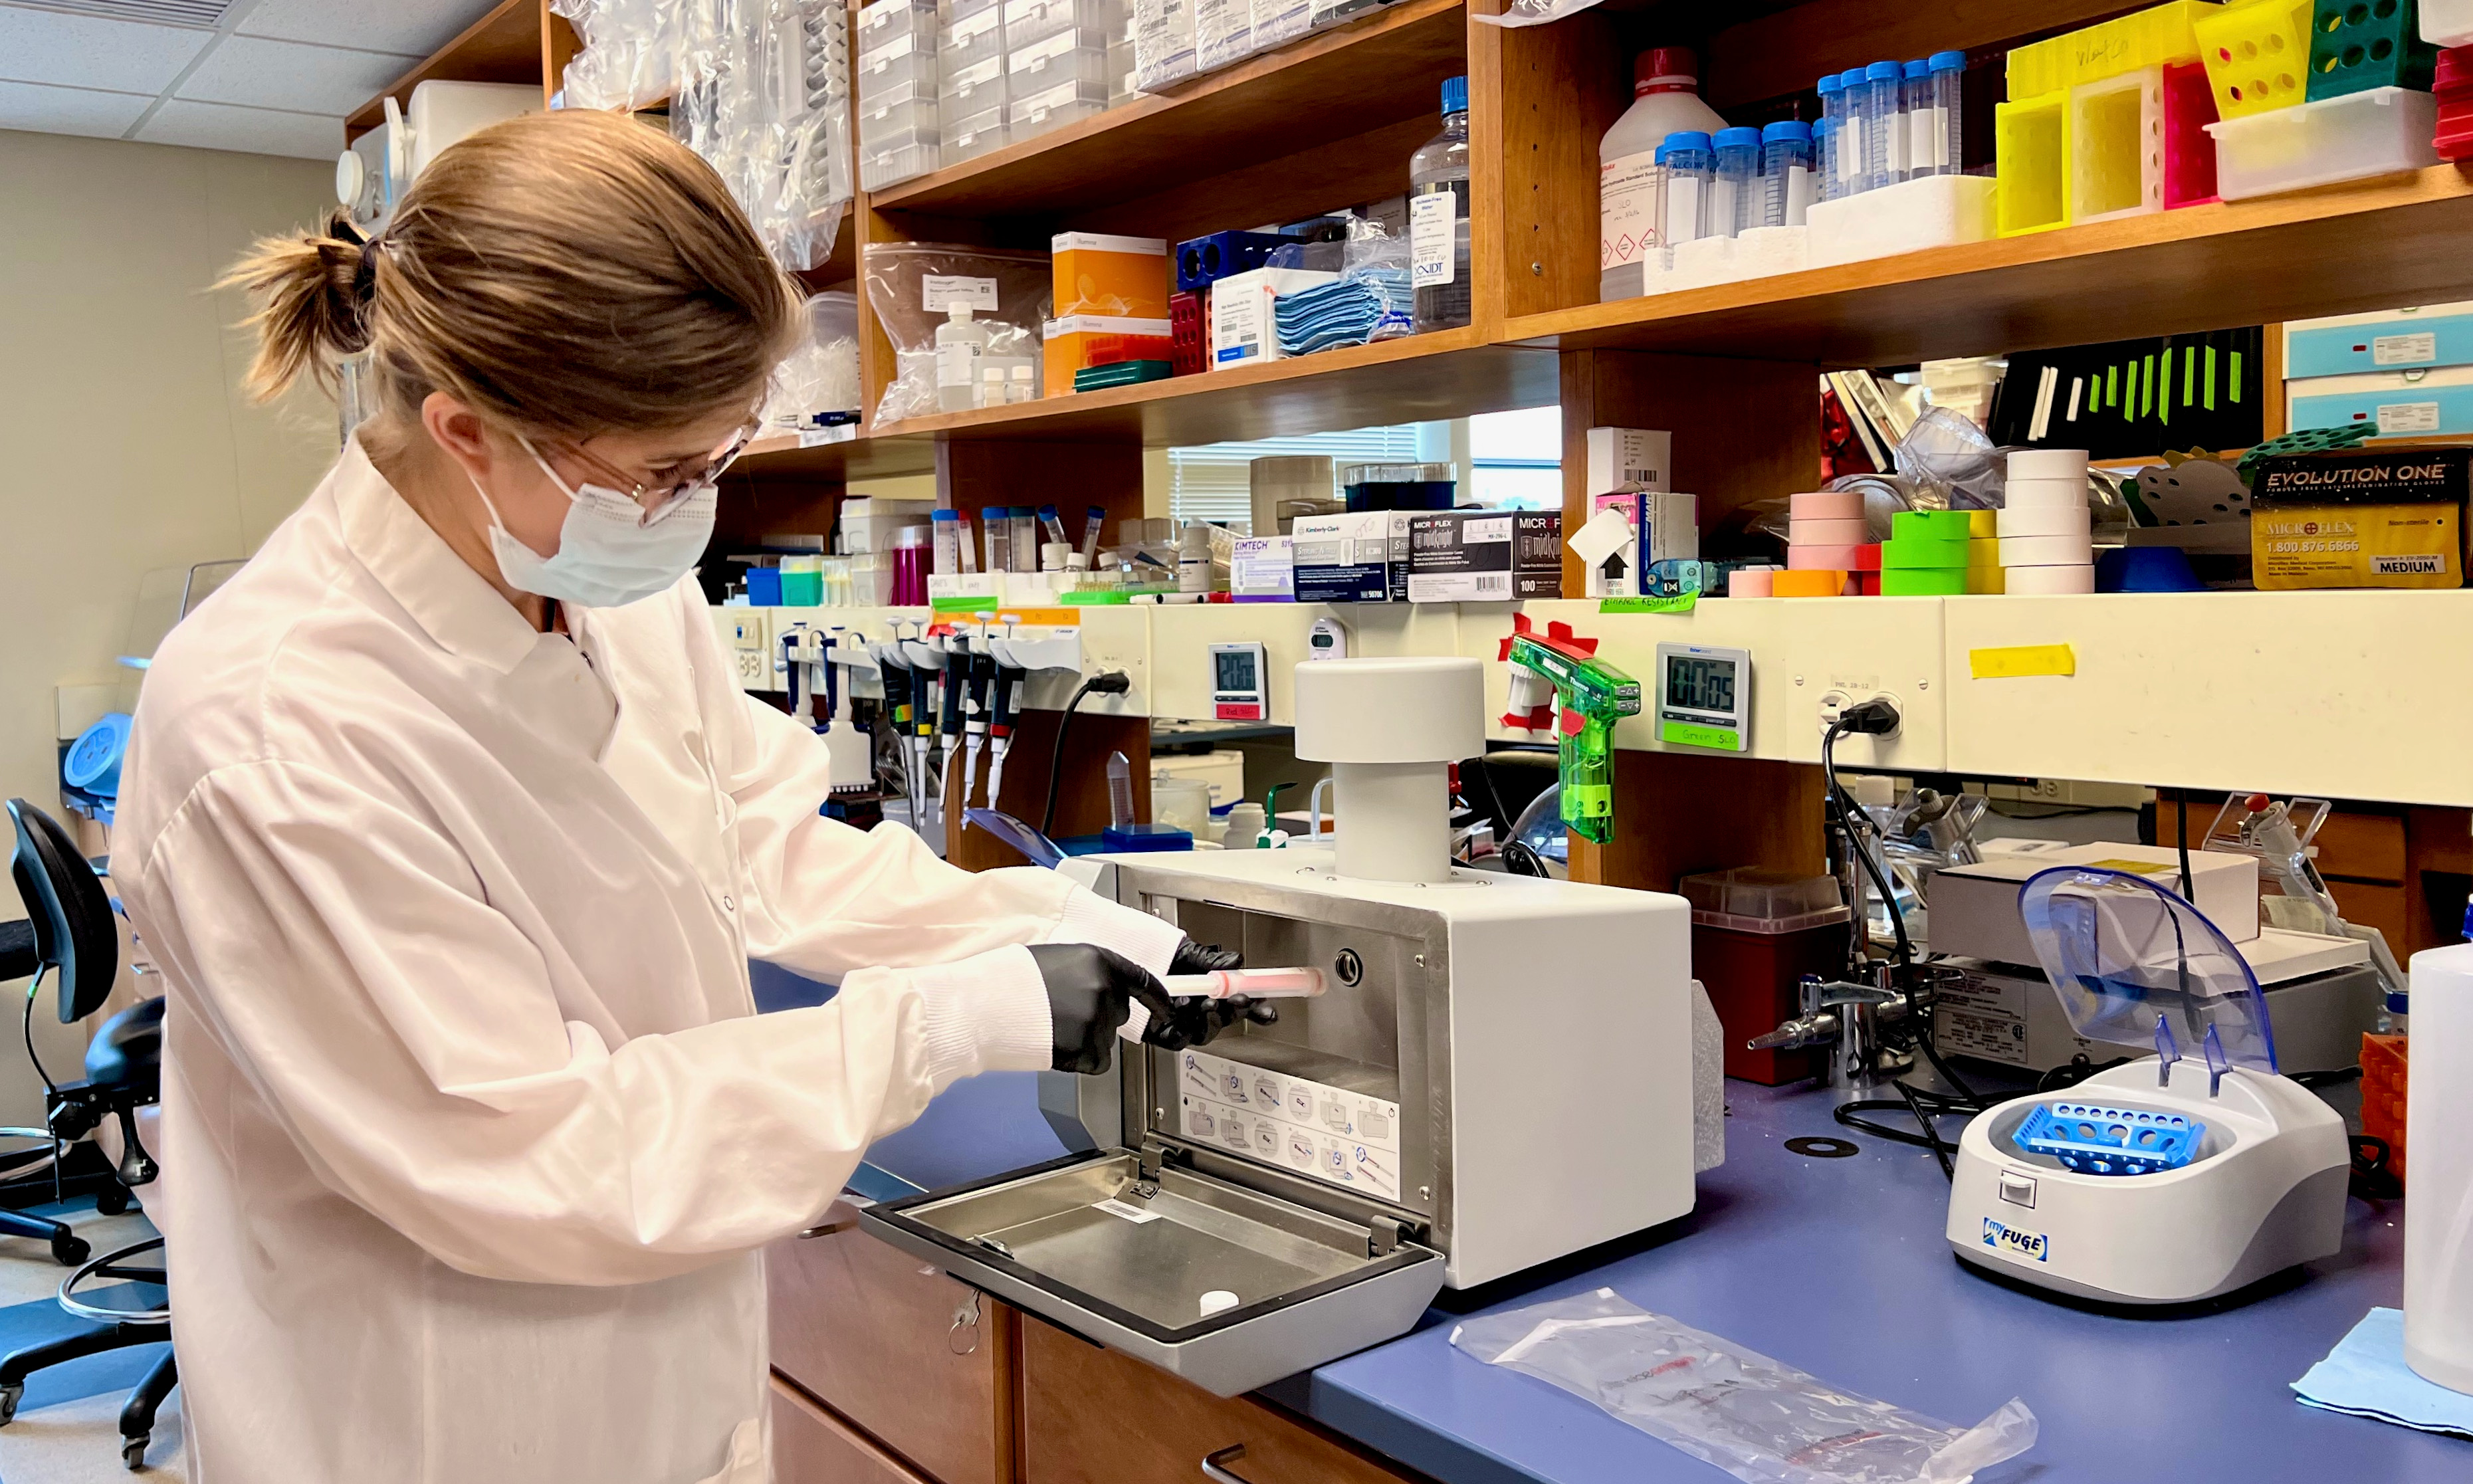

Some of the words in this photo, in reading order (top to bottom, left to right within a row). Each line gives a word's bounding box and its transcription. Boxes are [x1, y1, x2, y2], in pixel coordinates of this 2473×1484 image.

[1669, 161, 1705, 170] FALCON
[1430, 262, 1444, 274] IDT
[2267, 467, 2391, 486] EVOLUTION
[2397, 464, 2446, 480] ONE
[1414, 520, 1452, 529] MICROFLEX
[2267, 521, 2355, 536] MICROFLEX
[1423, 529, 1453, 549] midknight
[1235, 540, 1268, 551] KIMTECH
[2267, 540, 2359, 553] 1.800.876.6866
[2380, 562, 2436, 573] MEDIUM
[1520, 580, 1536, 592] 100
[1642, 595, 1687, 607] RESISTANT
[1569, 676, 1590, 692] Thermo
[1682, 729, 1711, 742] Green
